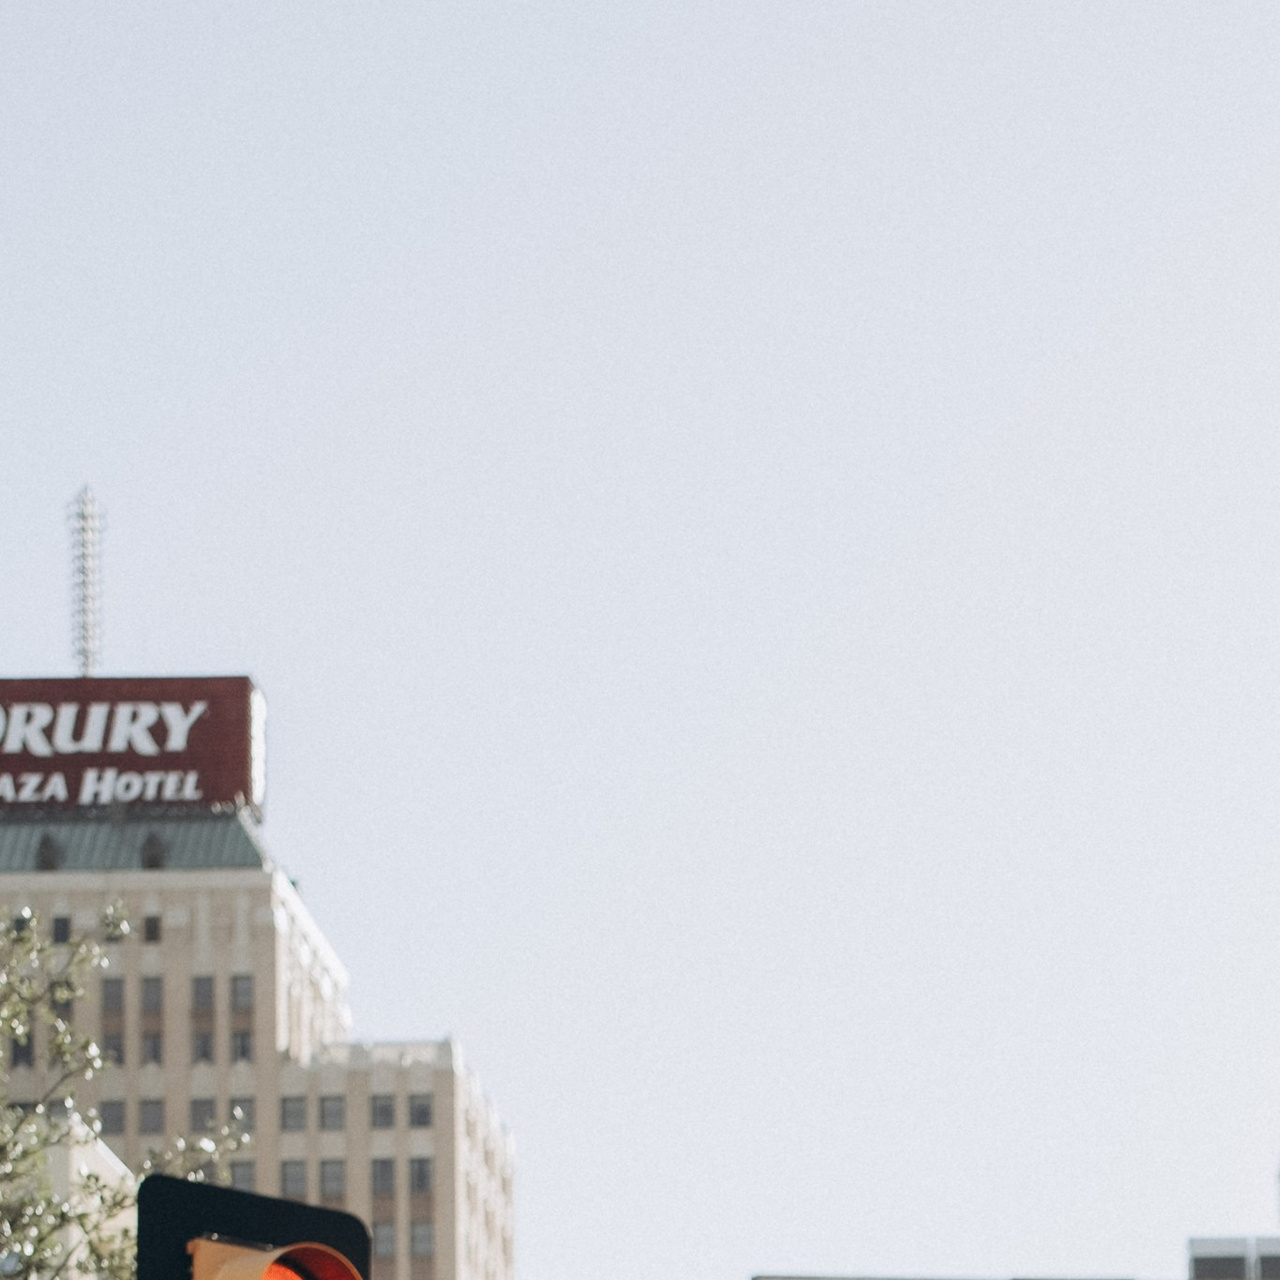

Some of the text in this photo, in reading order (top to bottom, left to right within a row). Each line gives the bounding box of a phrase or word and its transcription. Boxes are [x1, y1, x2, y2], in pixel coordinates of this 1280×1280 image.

[0, 701, 208, 757] RURY
[0, 766, 203, 806] AZA HOTEL
